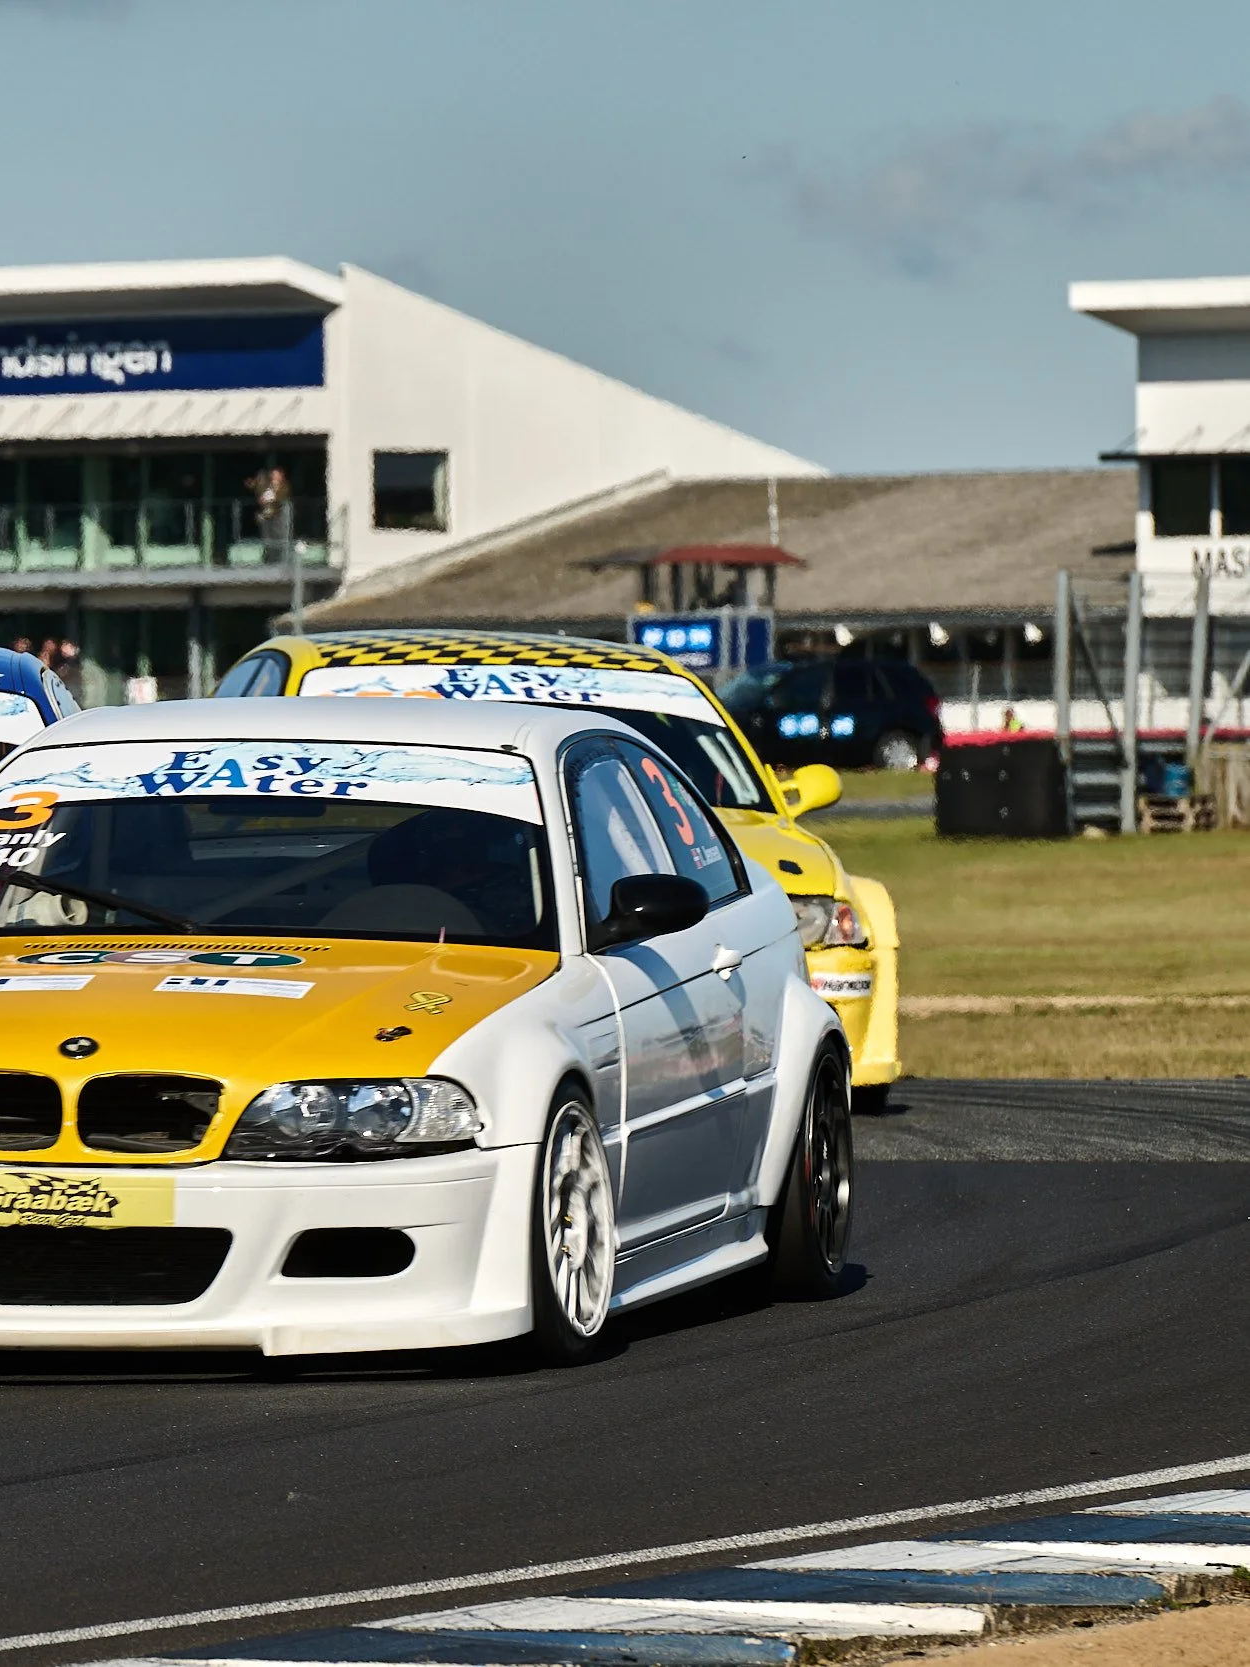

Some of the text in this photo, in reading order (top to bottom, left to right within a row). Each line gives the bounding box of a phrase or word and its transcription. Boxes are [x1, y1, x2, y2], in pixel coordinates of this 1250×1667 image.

[1192, 547, 1250, 579] MAS
[641, 757, 695, 845] 3
[34, 950, 283, 966] CST
